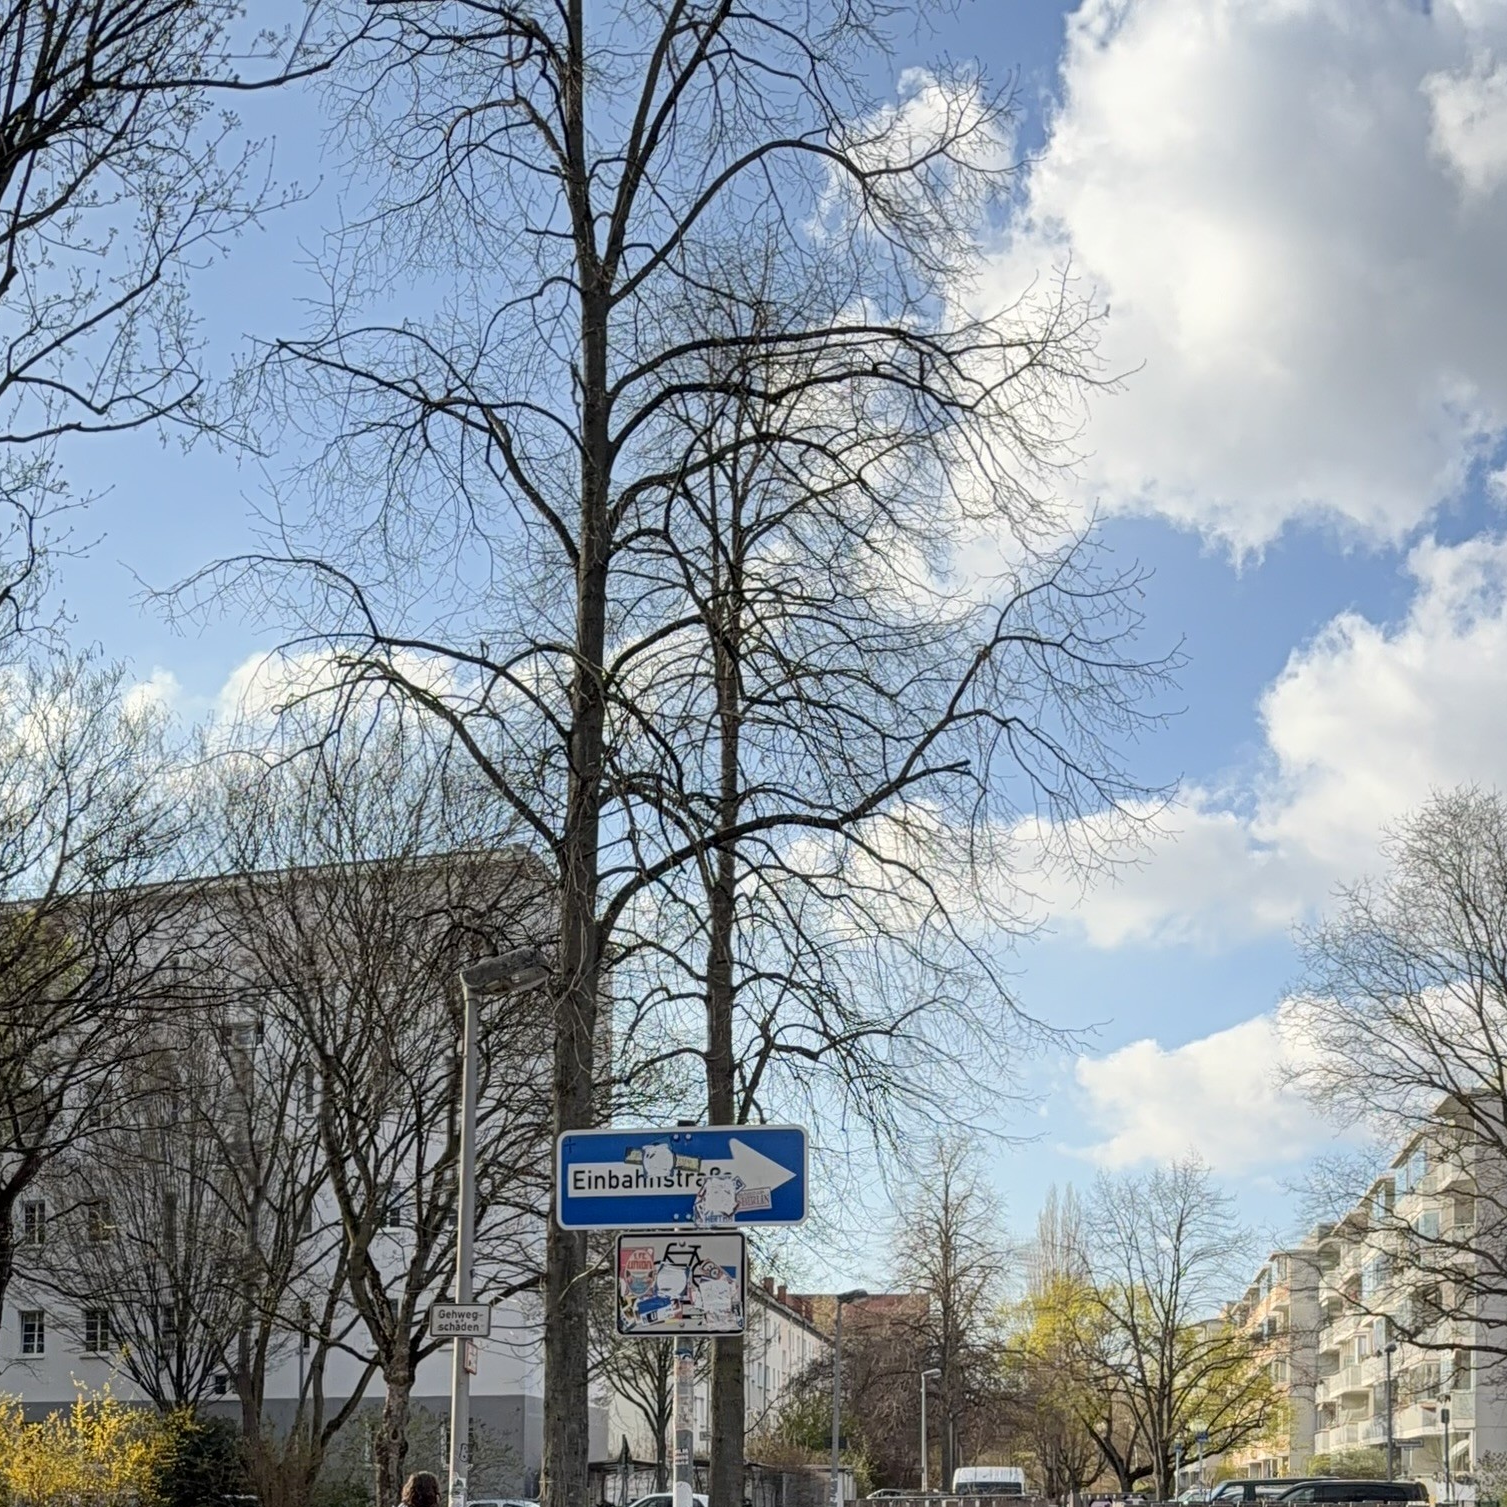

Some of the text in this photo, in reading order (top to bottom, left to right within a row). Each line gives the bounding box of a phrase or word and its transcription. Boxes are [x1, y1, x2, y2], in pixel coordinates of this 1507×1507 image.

[573, 1166, 732, 1190] Einbahnstra
[438, 1310, 484, 1321] Gehweg-
[438, 1320, 480, 1331] schäden
